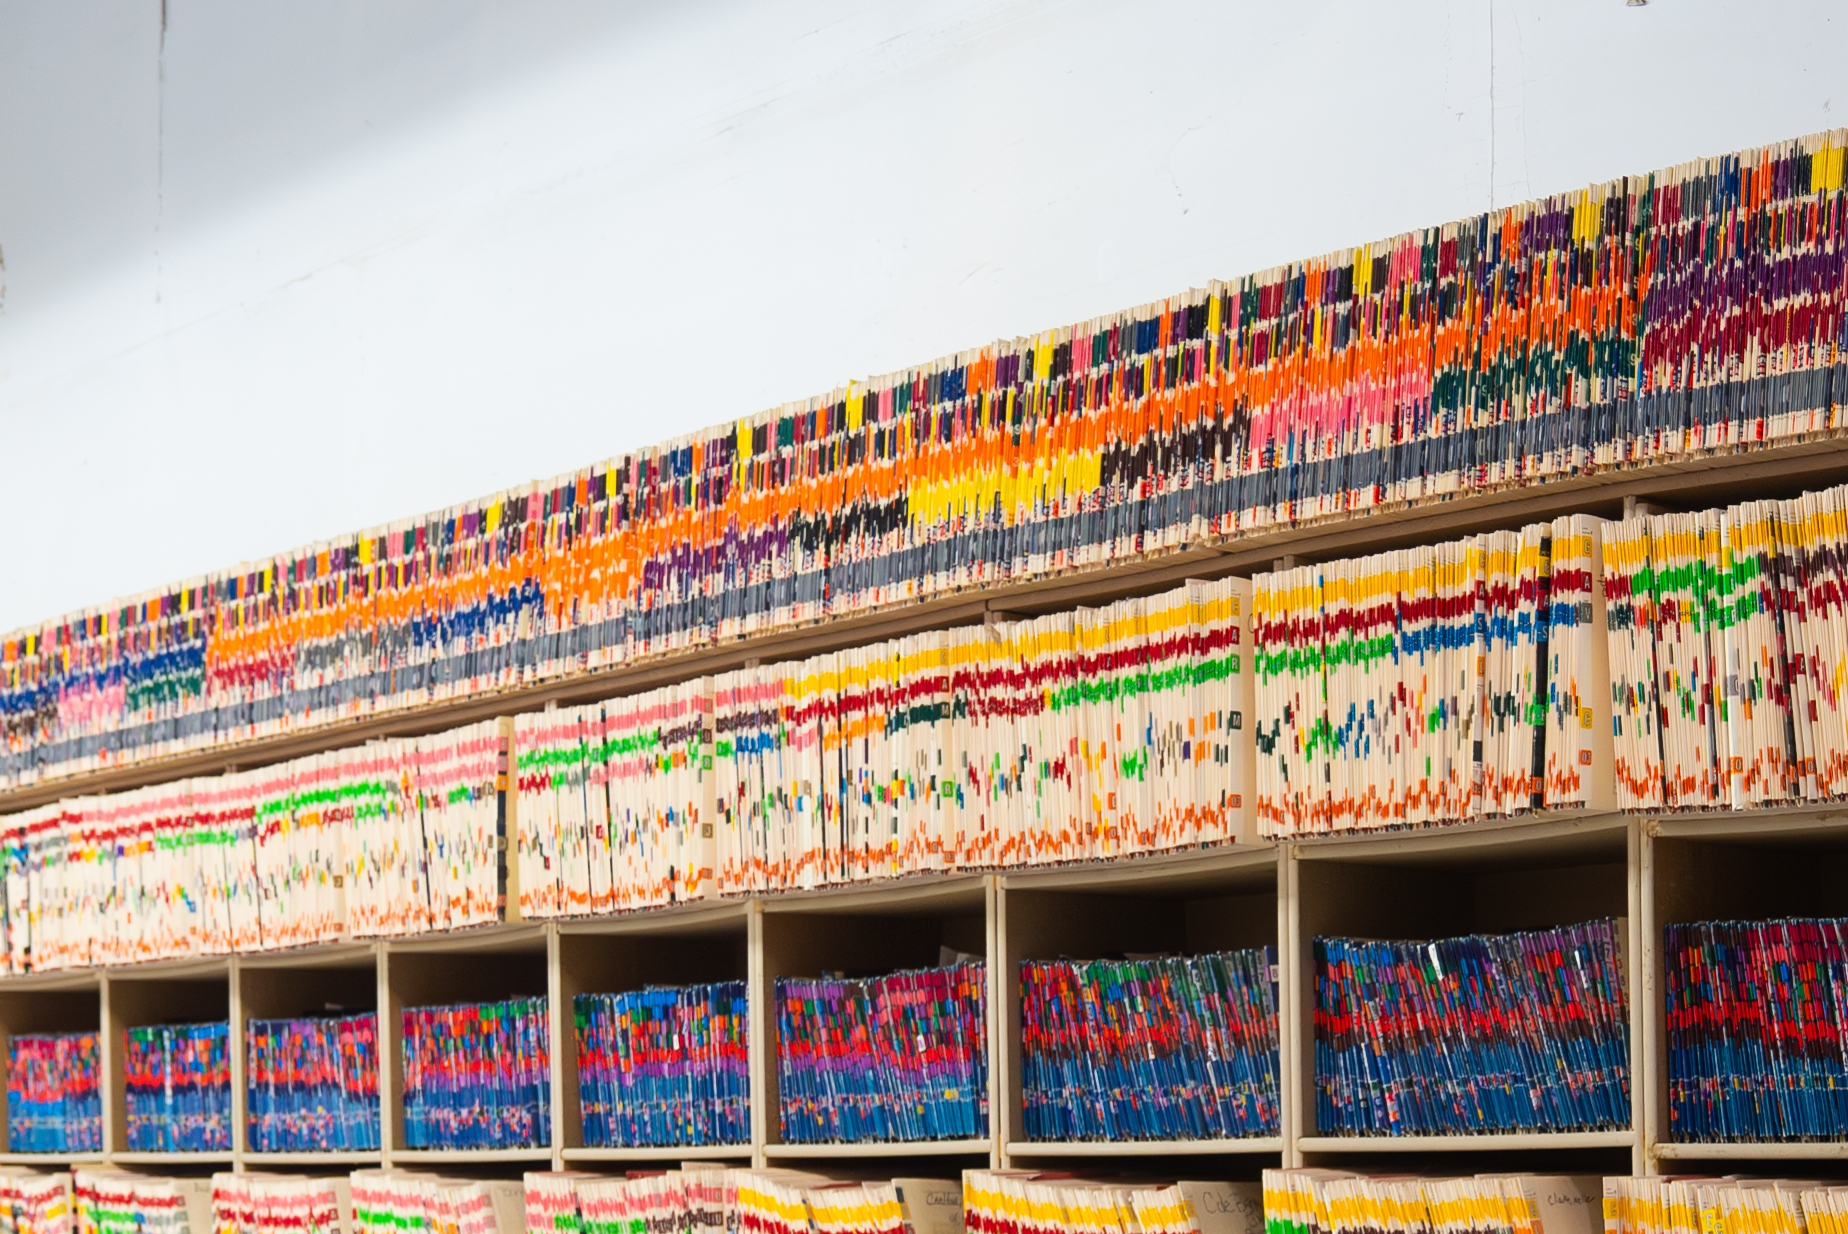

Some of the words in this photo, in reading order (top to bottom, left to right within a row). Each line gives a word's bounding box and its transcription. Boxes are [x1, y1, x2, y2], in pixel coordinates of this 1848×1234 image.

[1478, 582, 1485, 597] A
[1583, 575, 1591, 591] A
[1477, 617, 1483, 630] S
[1231, 628, 1240, 643] A
[1231, 657, 1239, 671] R
[1232, 713, 1241, 727] M
